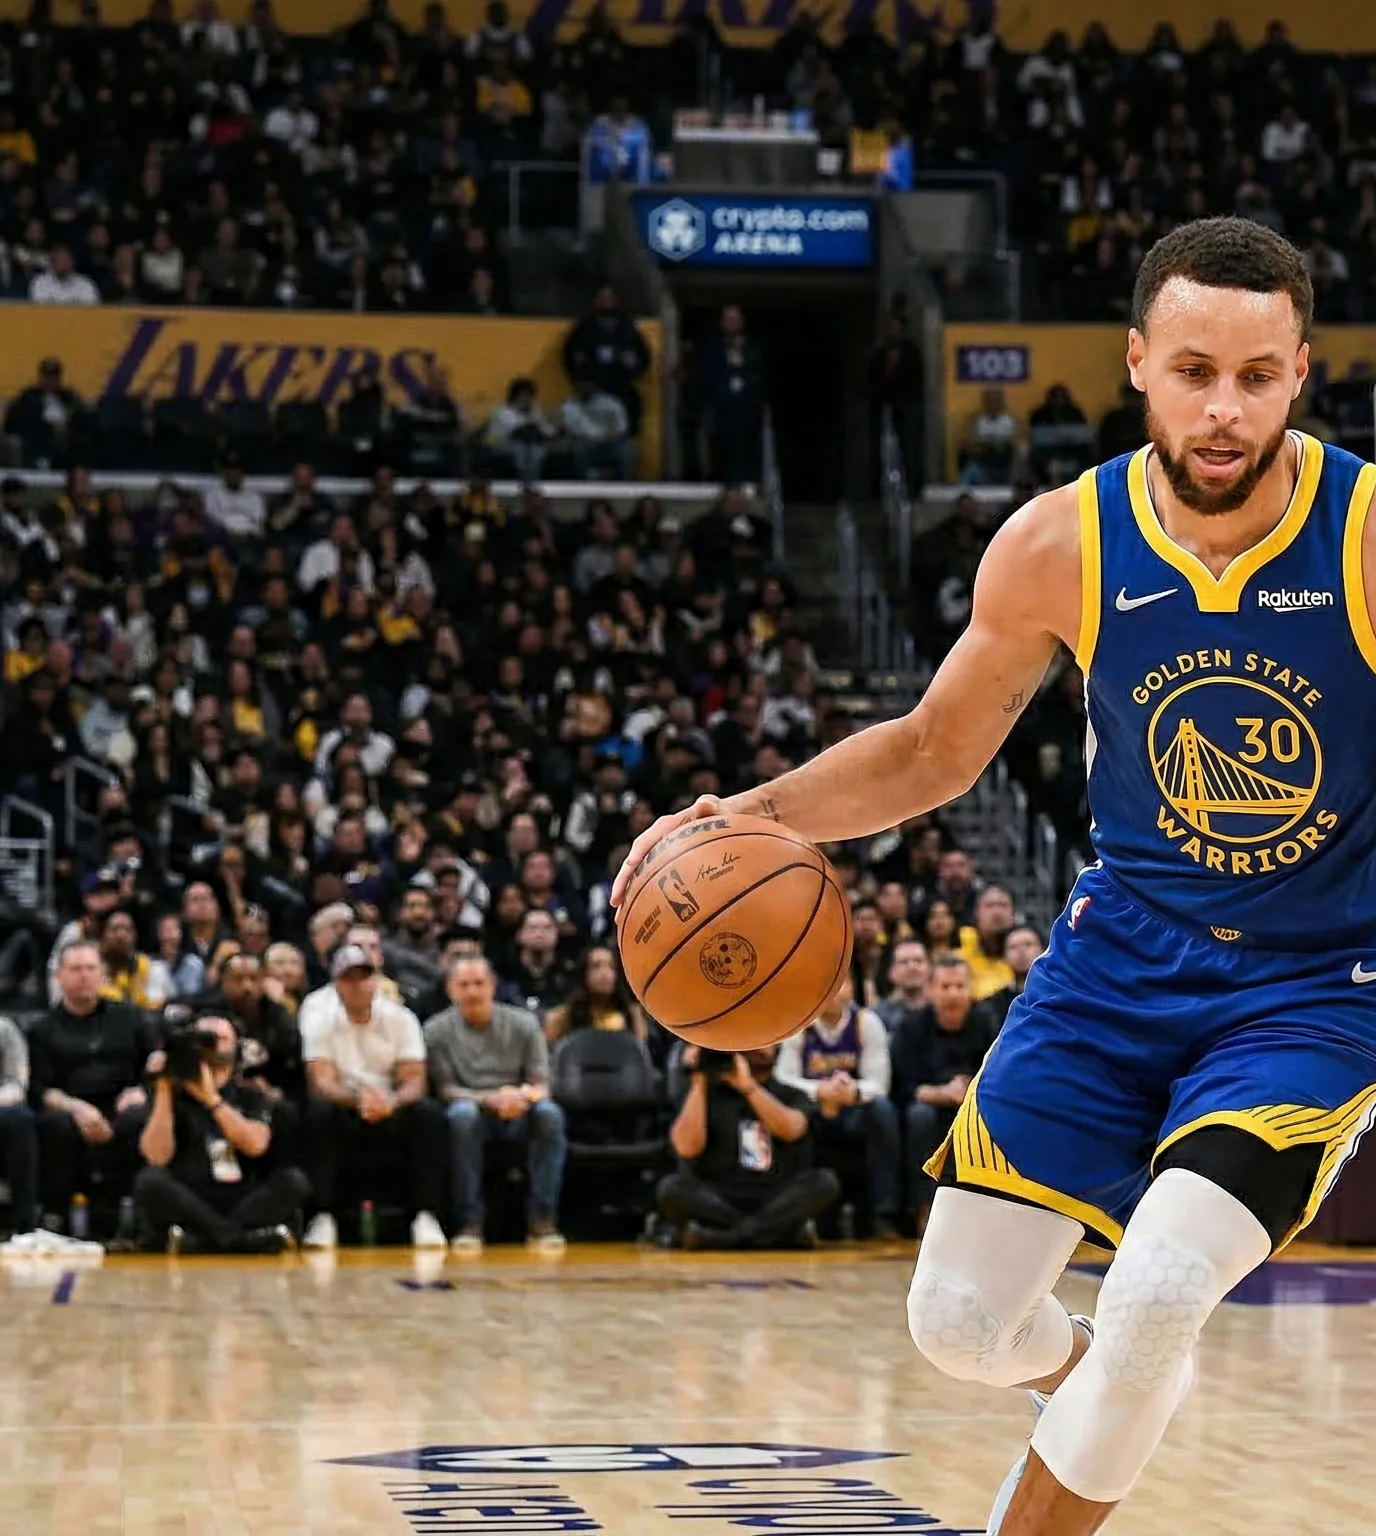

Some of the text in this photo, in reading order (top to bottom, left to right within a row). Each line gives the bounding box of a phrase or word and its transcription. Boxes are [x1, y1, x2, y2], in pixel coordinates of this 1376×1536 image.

[711, 205, 870, 232] crypto.com
[1257, 588, 1334, 612] Rakuten
[1131, 648, 1323, 708] GOLDEN STATE
[1234, 716, 1300, 764] 30
[1156, 804, 1339, 875] WARRIORS
[380, 1481, 604, 1536] Aren
